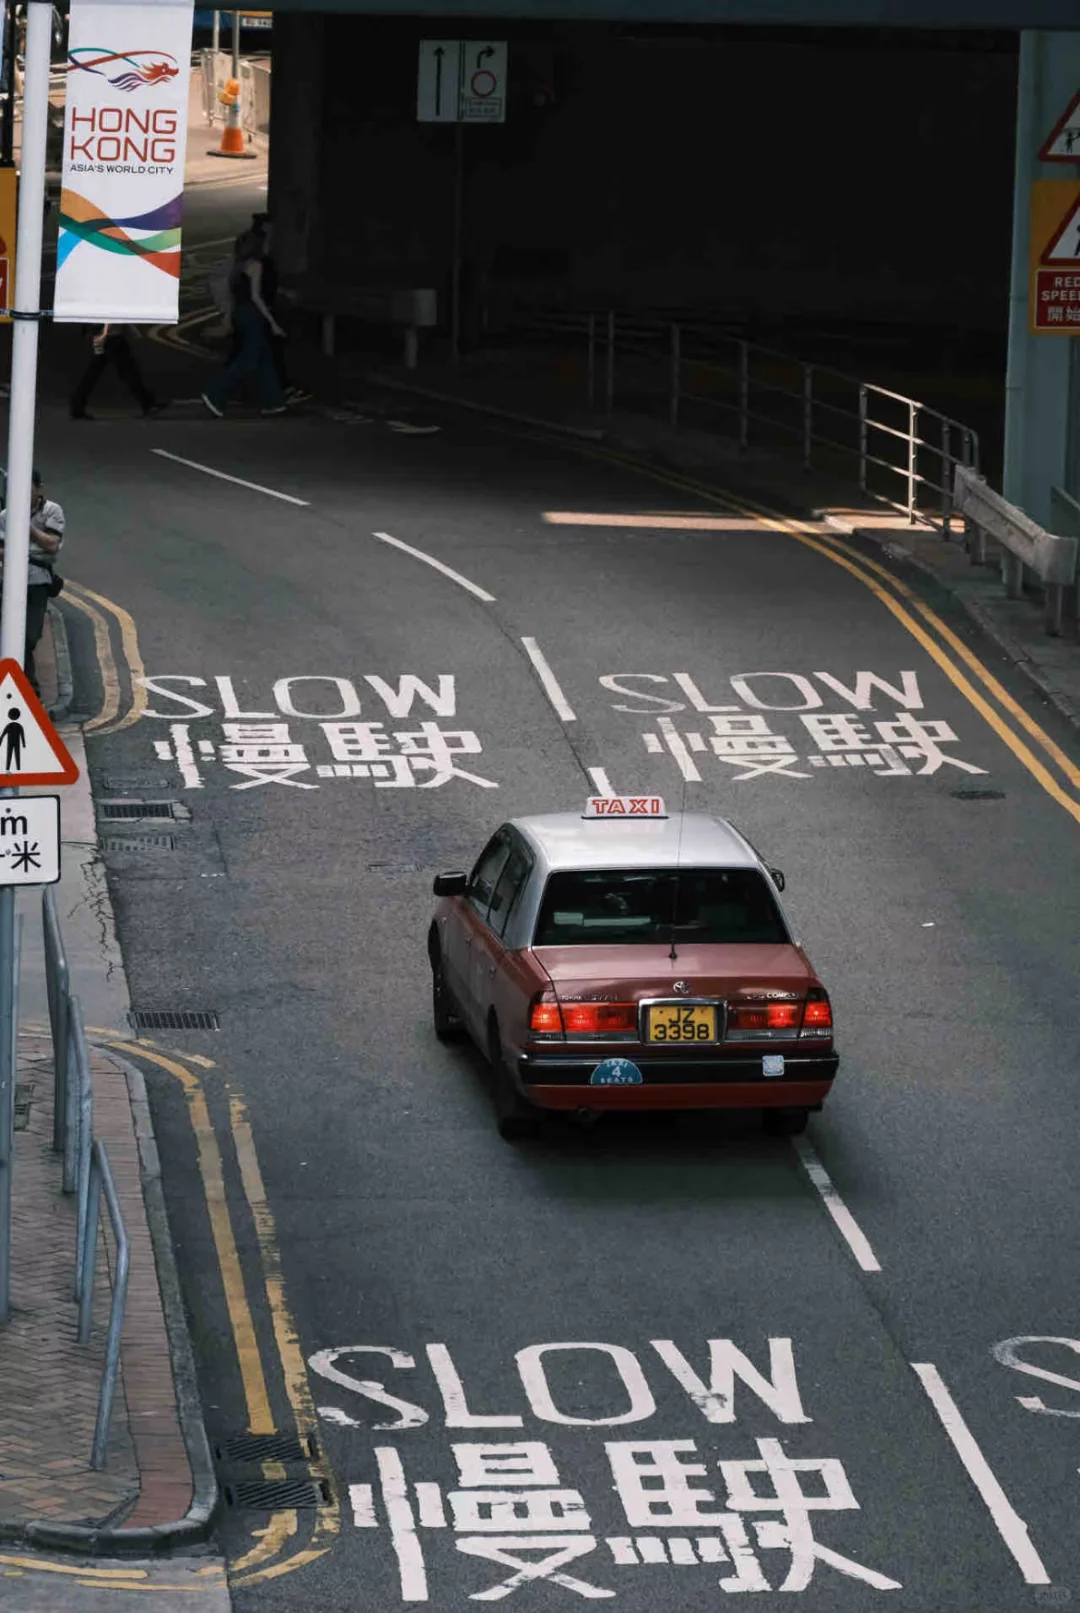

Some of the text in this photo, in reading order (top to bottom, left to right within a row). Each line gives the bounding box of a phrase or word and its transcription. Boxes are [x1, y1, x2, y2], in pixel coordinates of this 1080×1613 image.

[71, 107, 177, 135] HONG
[70, 136, 176, 163] KONG
[69, 164, 174, 175] ASIA'S WORLD CITY
[1041, 290, 1080, 301] SPEE
[136, 674, 456, 718] SLOW
[599, 671, 924, 713] SLOW
[153, 722, 500, 789] 慢駛
[642, 713, 989, 782] 慢駛
[591, 798, 660, 814] TAXI
[0, 840, 41, 873] 米
[668, 1007, 695, 1024] JZ
[654, 1023, 710, 1041] 3398
[611, 1065, 622, 1077] 4
[308, 1337, 813, 1430] SLOW
[348, 1438, 903, 1601] 慢駛
